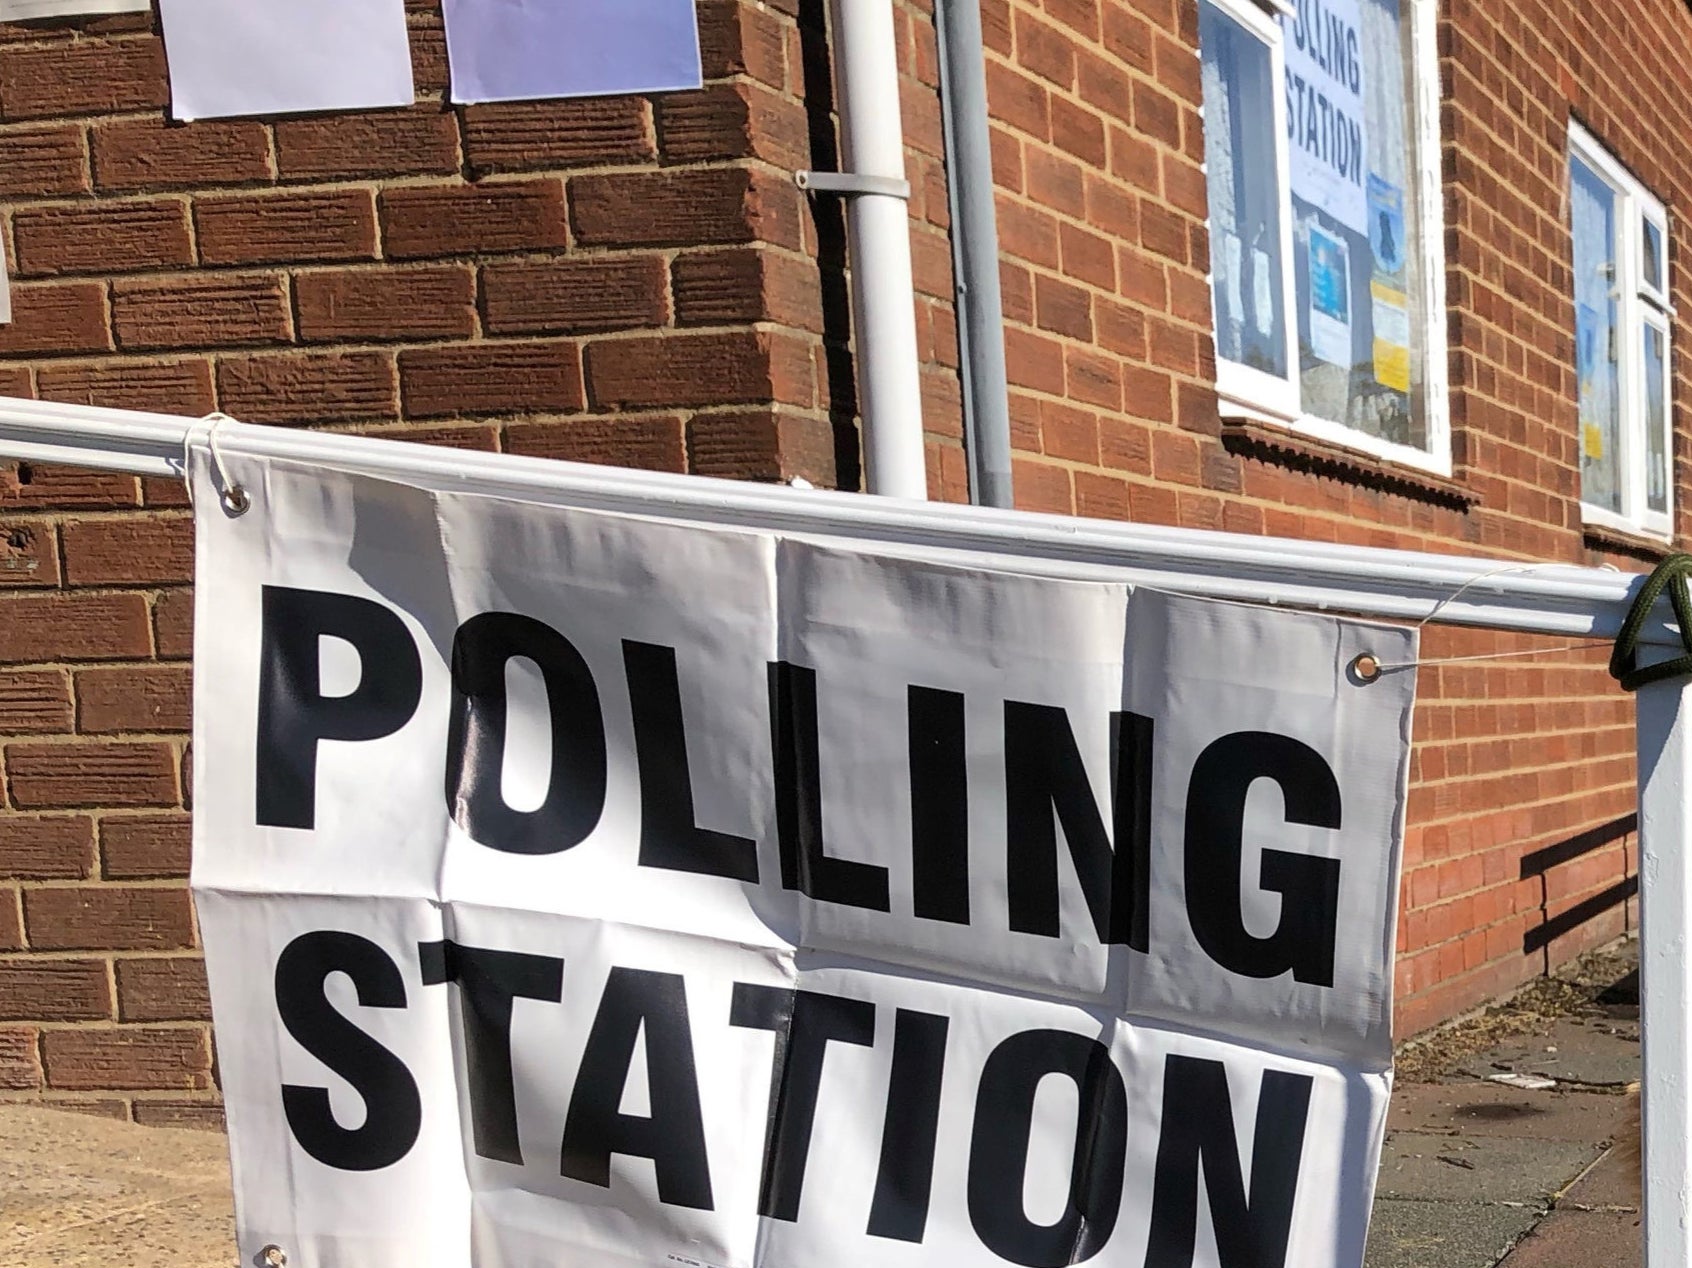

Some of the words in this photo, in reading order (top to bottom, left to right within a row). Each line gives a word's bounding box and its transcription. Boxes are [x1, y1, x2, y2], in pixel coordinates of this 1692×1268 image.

[1279, 0, 1360, 96] OLLING
[1285, 63, 1361, 187] STATION
[255, 584, 1343, 988] POLLING
